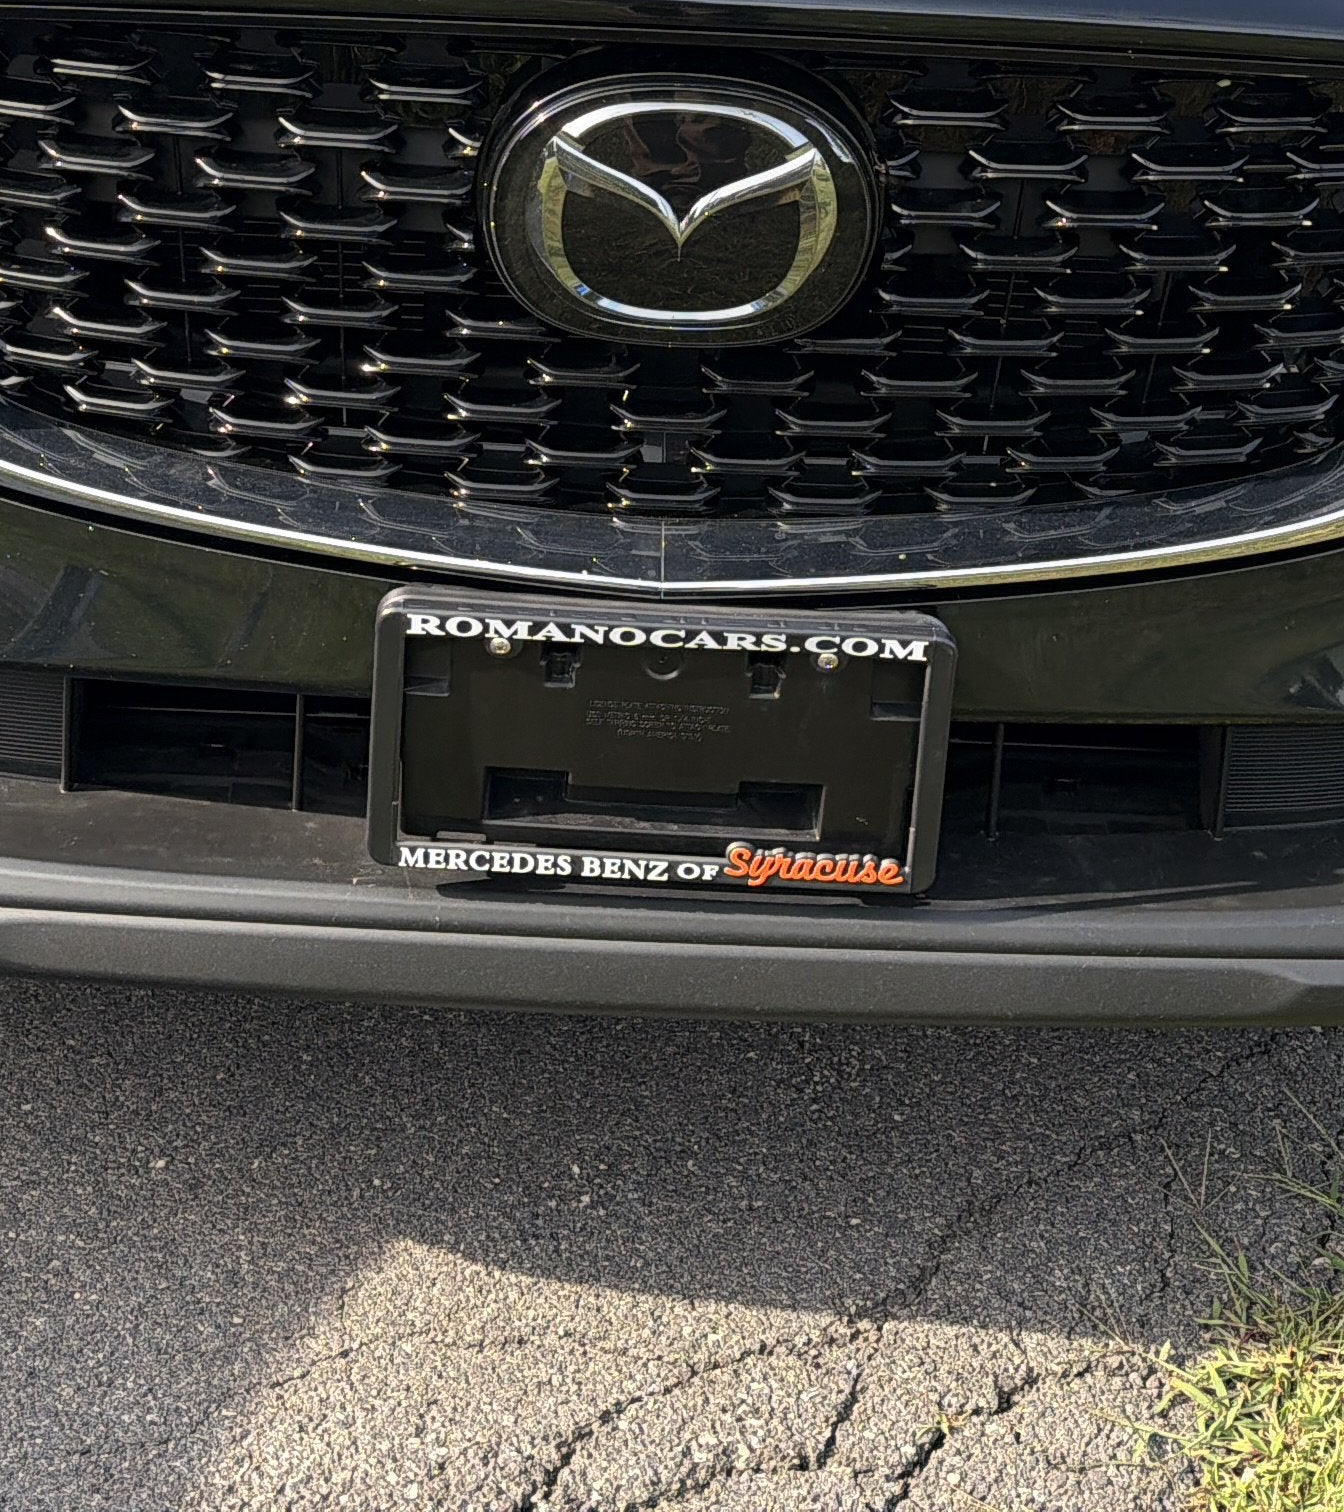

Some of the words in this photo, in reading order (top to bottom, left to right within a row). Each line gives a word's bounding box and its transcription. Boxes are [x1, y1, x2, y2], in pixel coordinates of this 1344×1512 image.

[406, 613, 928, 661] ROMANOCARS.COM
[398, 847, 571, 876] MERCEDES
[581, 856, 668, 881] BENZ
[676, 863, 720, 881] OF
[723, 842, 903, 886] Syracuse
